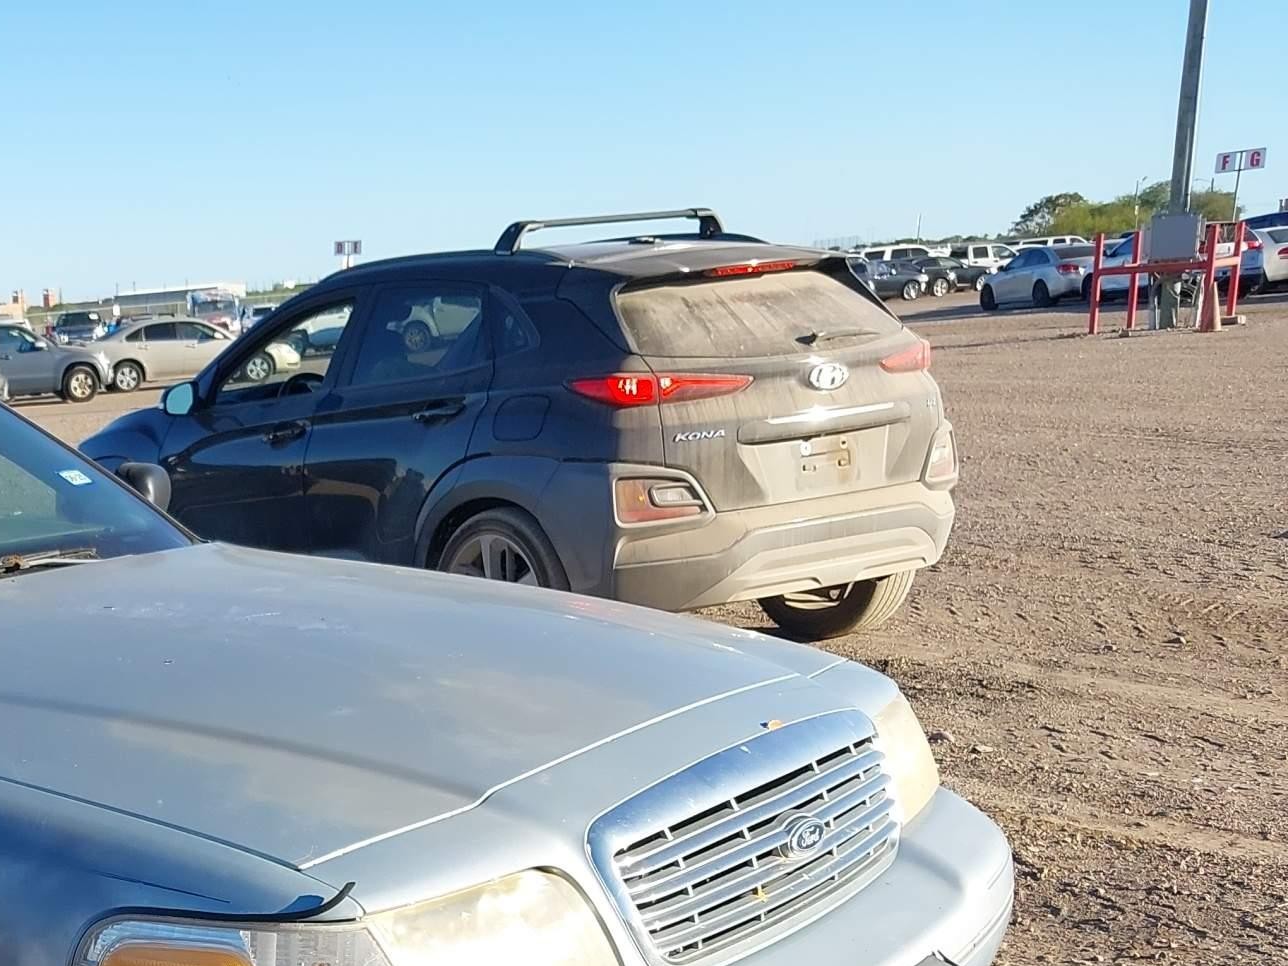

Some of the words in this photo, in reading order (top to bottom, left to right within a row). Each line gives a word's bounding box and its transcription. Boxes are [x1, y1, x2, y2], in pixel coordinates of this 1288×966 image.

[1221, 154, 1231, 170] F
[1249, 151, 1261, 167] G
[673, 429, 725, 442] KONA
[800, 825, 821, 847] Ford
